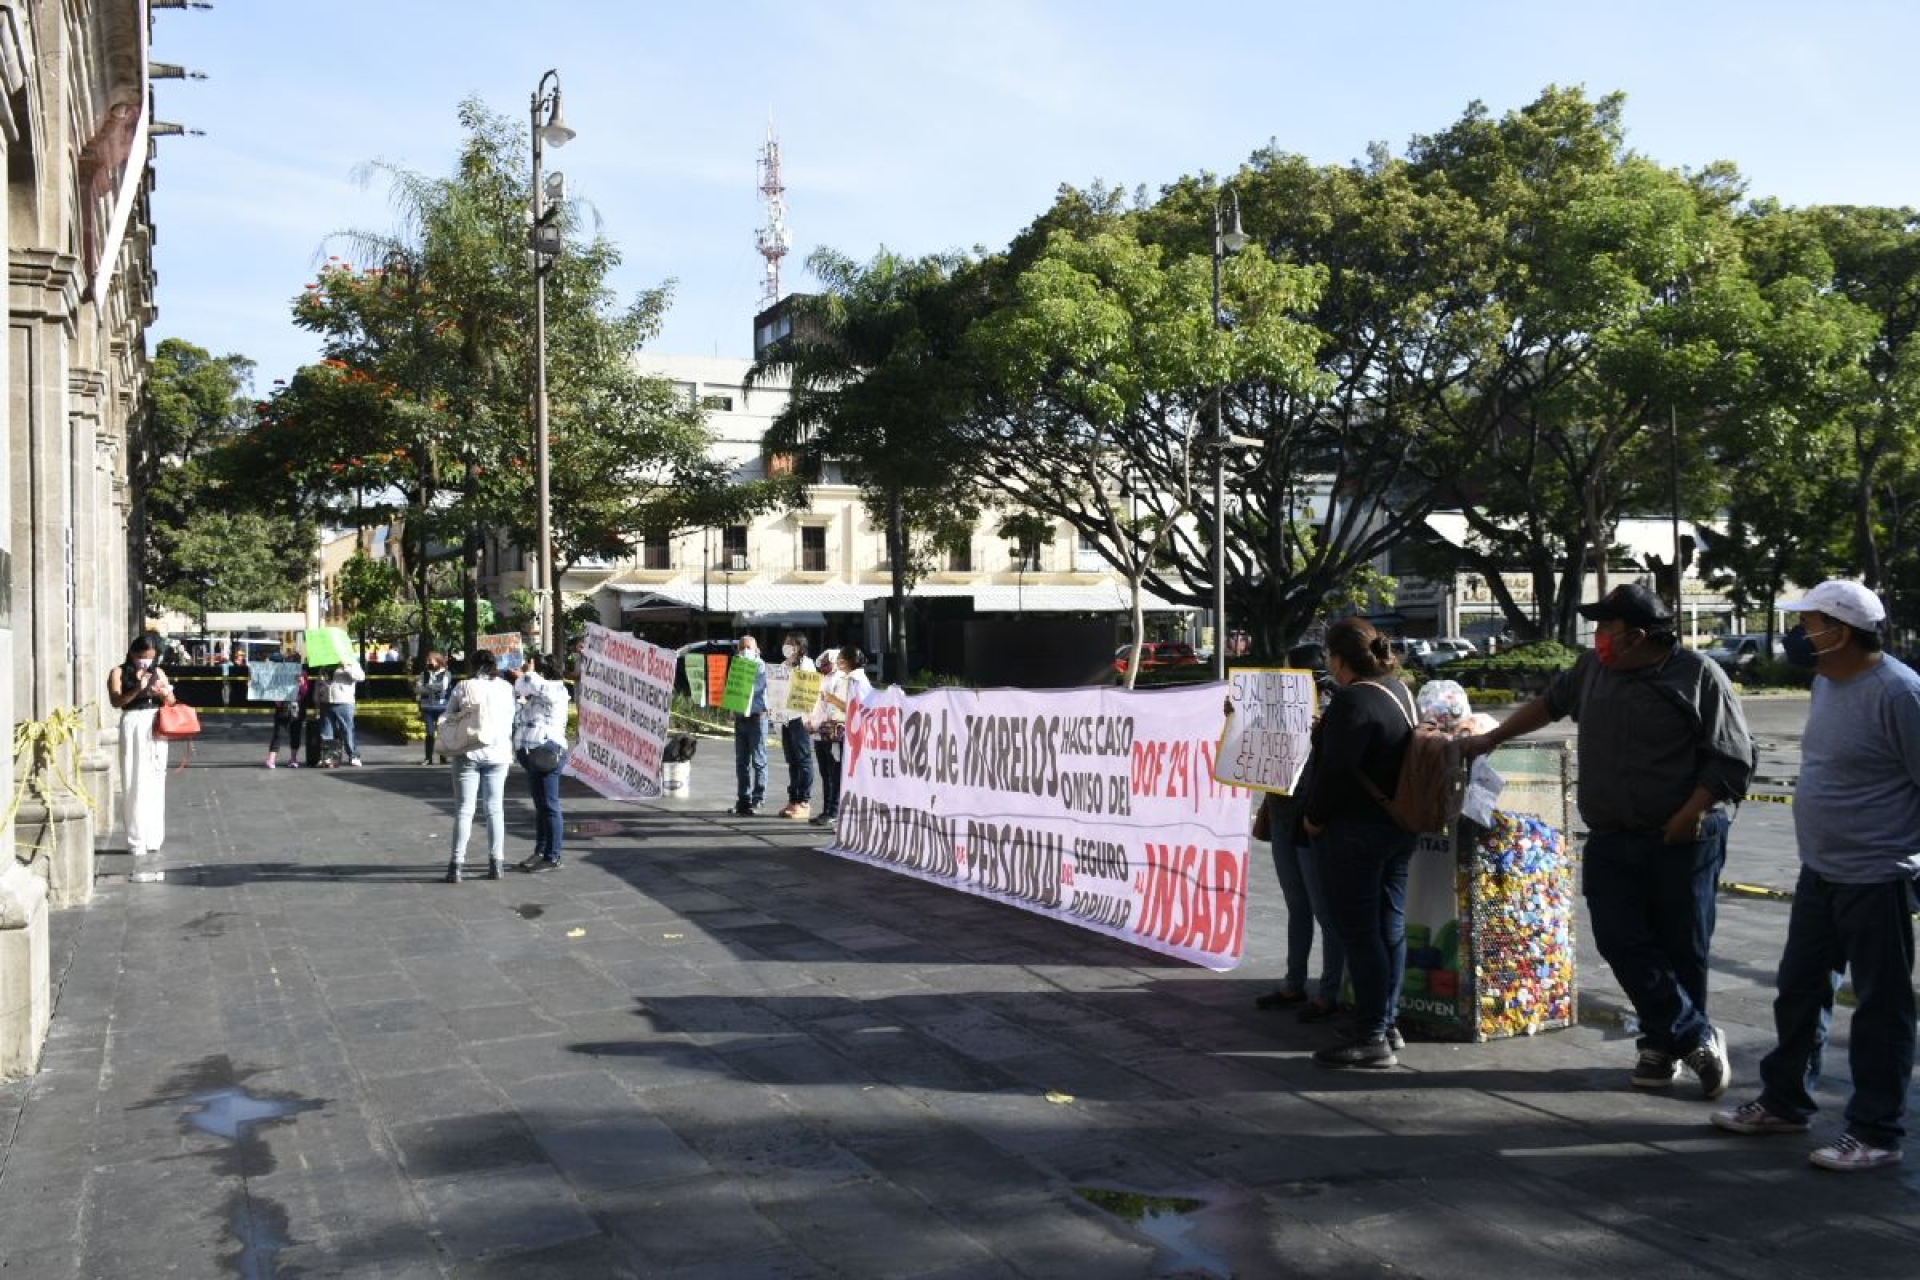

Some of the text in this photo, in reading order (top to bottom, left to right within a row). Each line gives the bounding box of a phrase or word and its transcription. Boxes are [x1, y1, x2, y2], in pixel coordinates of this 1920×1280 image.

[935, 709, 959, 785] de
[964, 714, 1060, 797] MORELOS
[1060, 715, 1134, 757] HACE CASO
[870, 757, 897, 779] Y EL
[1131, 740, 1168, 797] DOF
[1060, 771, 1131, 816] OMISO DEL
[967, 819, 1063, 908] PERSONAL
[1061, 837, 1129, 887] DEL SEGURO
[1069, 890, 1131, 929] POPULAR
[1134, 843, 1249, 958] INSABI
